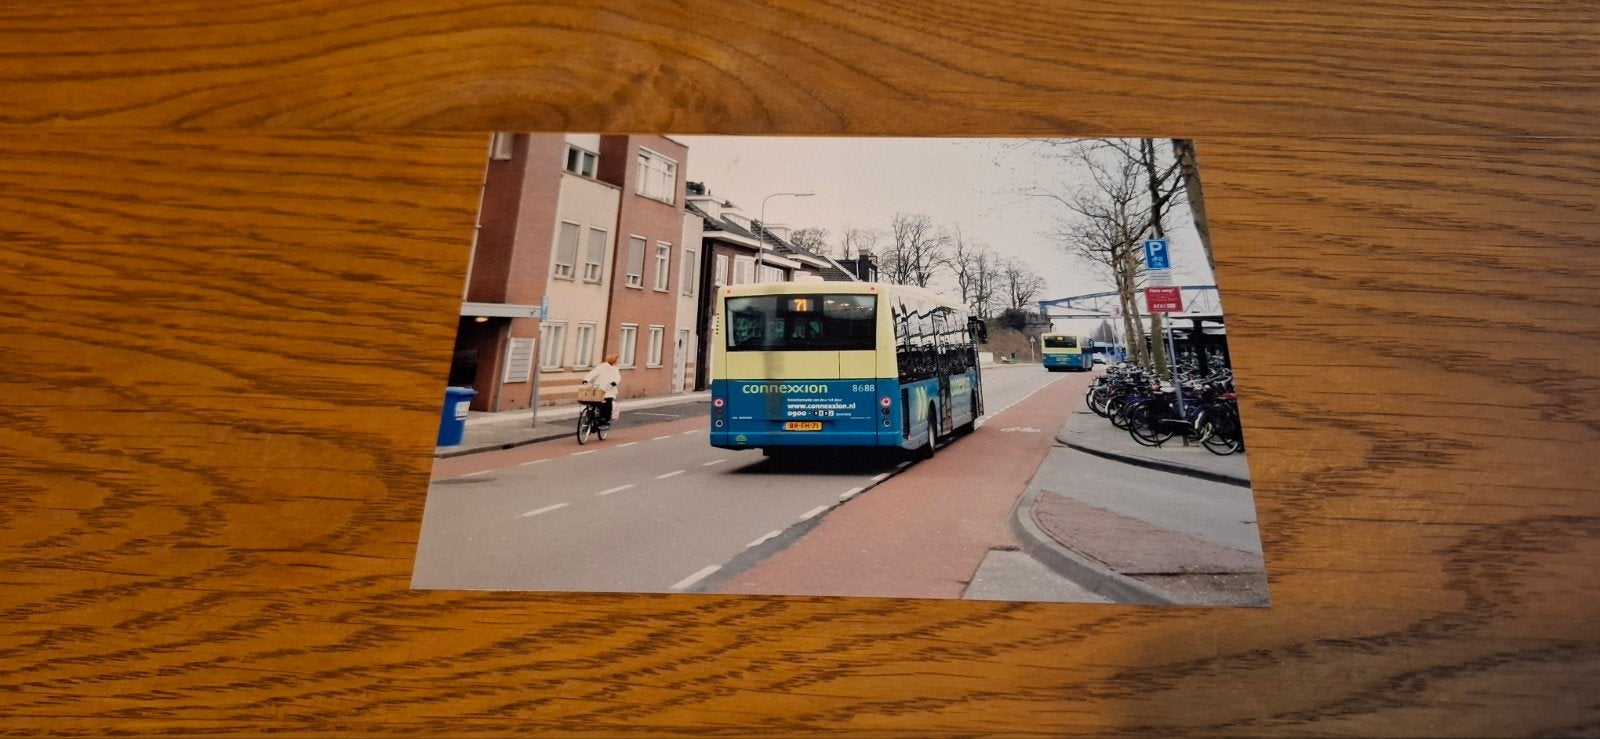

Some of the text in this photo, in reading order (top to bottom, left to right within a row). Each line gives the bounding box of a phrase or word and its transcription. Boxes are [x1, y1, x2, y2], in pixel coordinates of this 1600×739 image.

[1149, 241, 1162, 256] P
[794, 298, 807, 311] 71
[742, 384, 828, 394] connexxion
[852, 384, 875, 392] 8688
